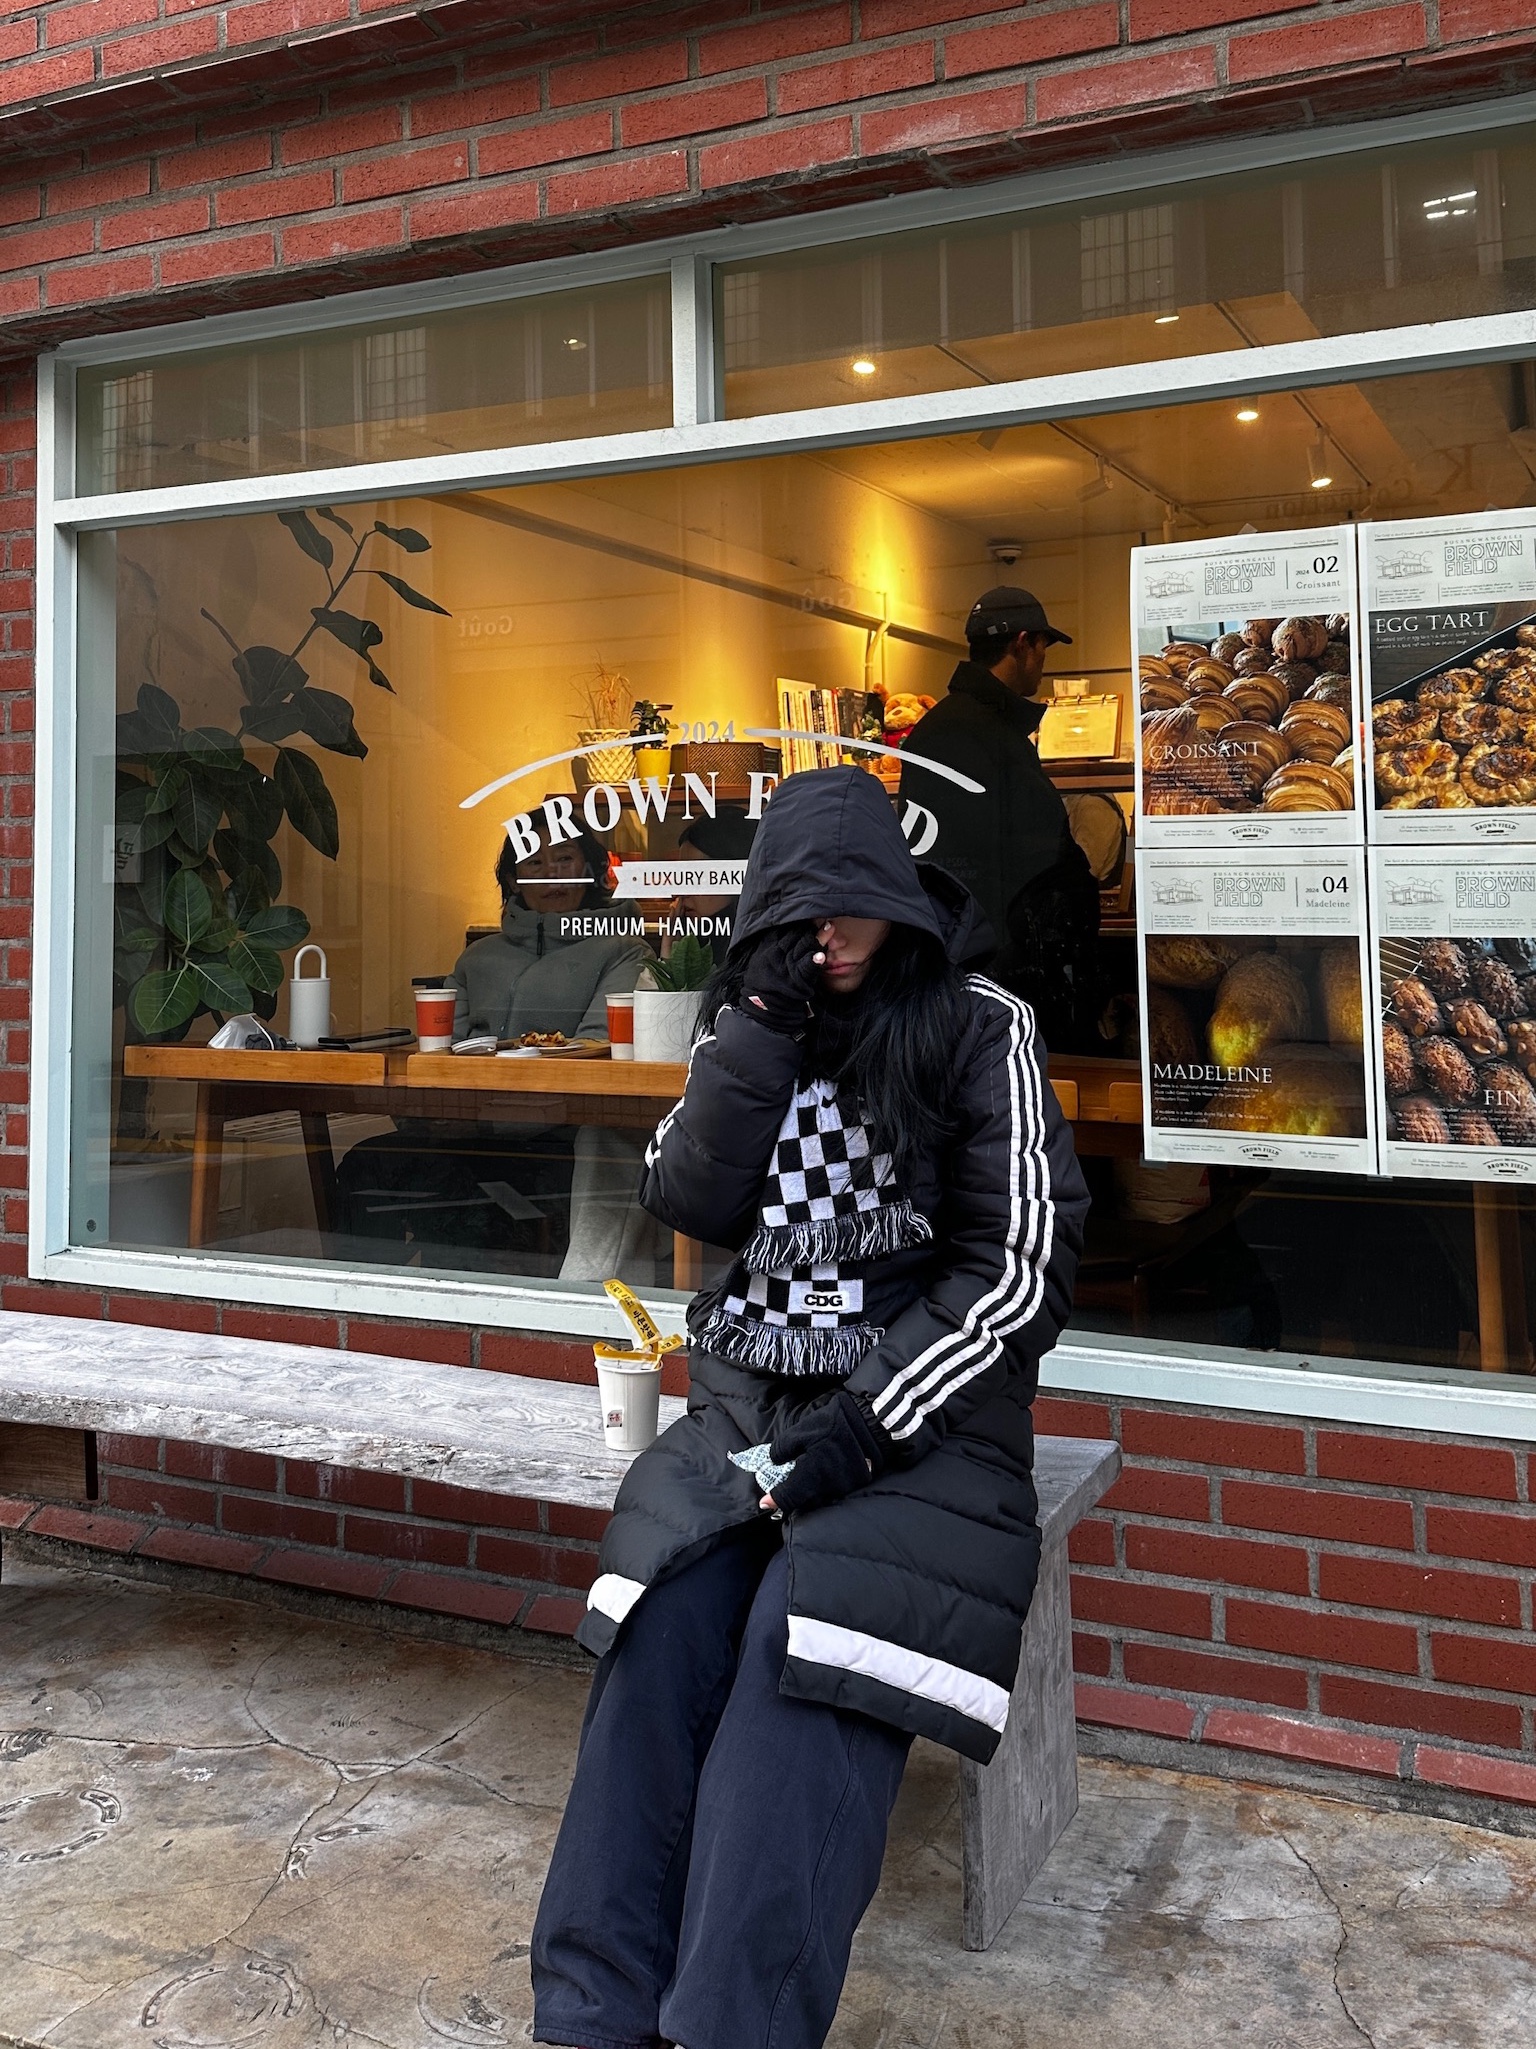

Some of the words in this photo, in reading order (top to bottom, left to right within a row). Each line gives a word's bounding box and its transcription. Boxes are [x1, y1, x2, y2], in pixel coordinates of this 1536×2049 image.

[1444, 540, 1523, 561] BROWN
[1204, 561, 1276, 580] BROWN
[1313, 555, 1339, 574] 02
[1444, 558, 1498, 577] FIELD
[1204, 578, 1253, 596] FIELD
[1295, 580, 1341, 590] Croissant
[1375, 616, 1419, 634] EGG
[1425, 611, 1489, 631] TART
[679, 720, 736, 744] 2024
[1149, 741, 1261, 760] CROISSANT
[501, 771, 720, 864] BROWN
[643, 871, 704, 886] LUXURY
[1213, 877, 1286, 892] BROWN
[1322, 876, 1350, 894] 04
[1455, 876, 1536, 892] BROWN
[1213, 891, 1263, 908] FIELD
[1306, 899, 1350, 908] Madeleine
[1455, 891, 1511, 908] FIELD
[560, 916, 645, 937] PREMIUM
[658, 916, 731, 937] HANDM
[1153, 1063, 1274, 1084] MADELEINE
[804, 1294, 843, 1307] CDG
